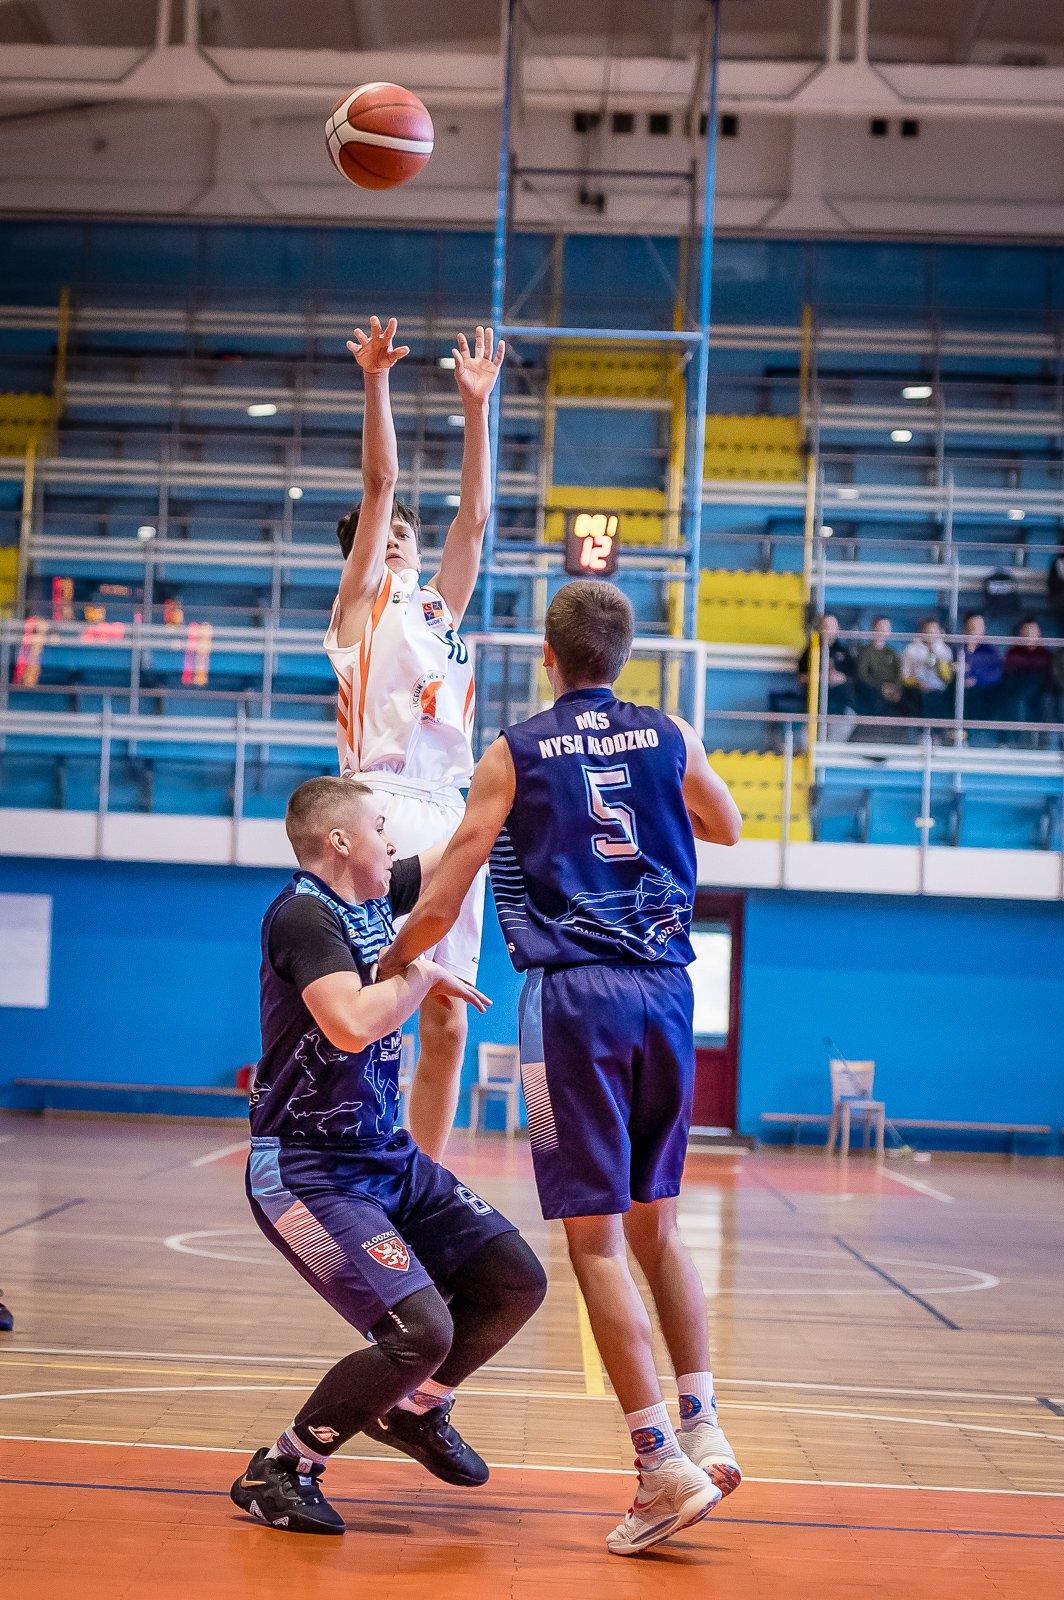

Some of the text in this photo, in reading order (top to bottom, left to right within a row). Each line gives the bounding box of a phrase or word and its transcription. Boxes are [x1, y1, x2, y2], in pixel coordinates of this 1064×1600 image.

[580, 536, 613, 571] 12
[412, 683, 423, 708] LICEUM
[575, 710, 610, 731] MKS
[538, 735, 585, 759] NYSA
[581, 763, 643, 863] 5
[361, 1230, 396, 1250] KŁODZKO
